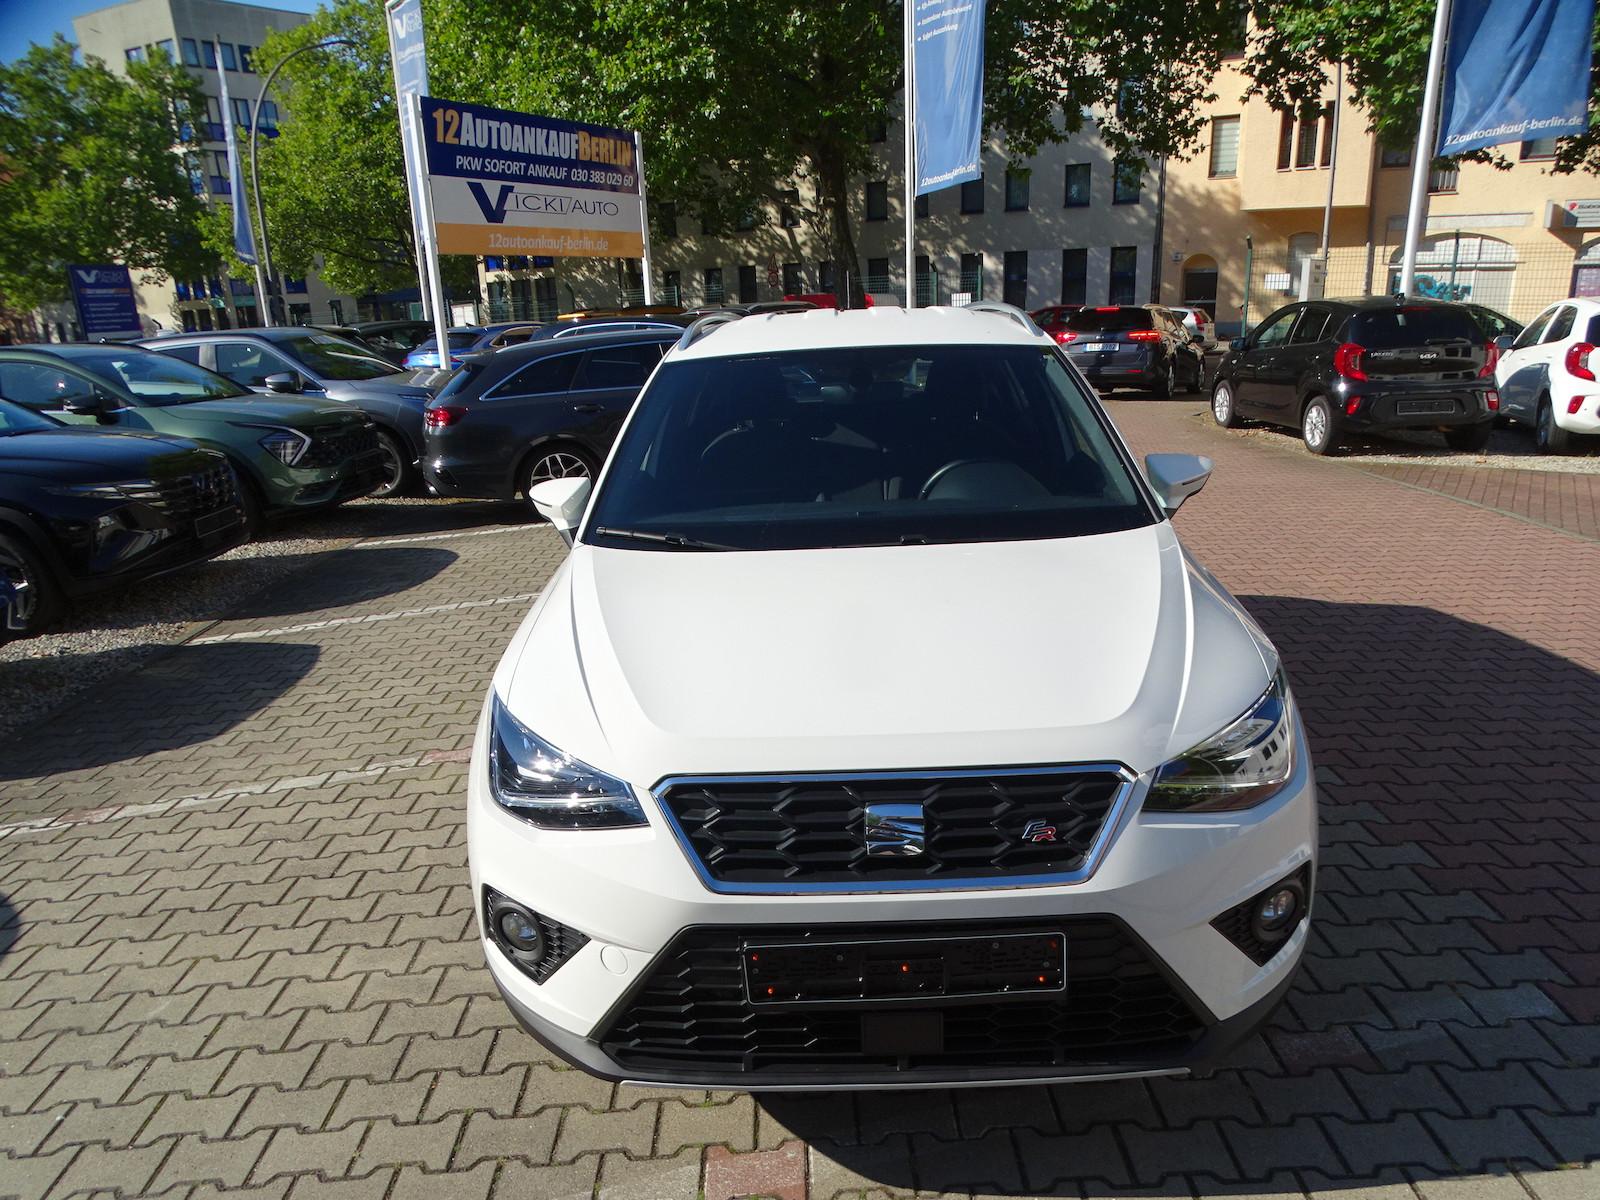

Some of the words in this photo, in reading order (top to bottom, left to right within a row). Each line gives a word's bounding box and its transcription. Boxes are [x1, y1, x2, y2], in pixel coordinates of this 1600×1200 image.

[1444, 115, 1583, 146] 12autoankauf-berlin.de
[456, 155, 482, 171] PKW
[485, 160, 526, 175] SOFORT
[528, 164, 568, 181] ANKAUF
[571, 168, 588, 182] 030
[589, 170, 606, 184] 383
[606, 172, 622, 186] 029
[623, 174, 634, 187] 60
[572, 199, 619, 217] AUTO
[489, 233, 609, 253] 12autoankauf-berlin.de
